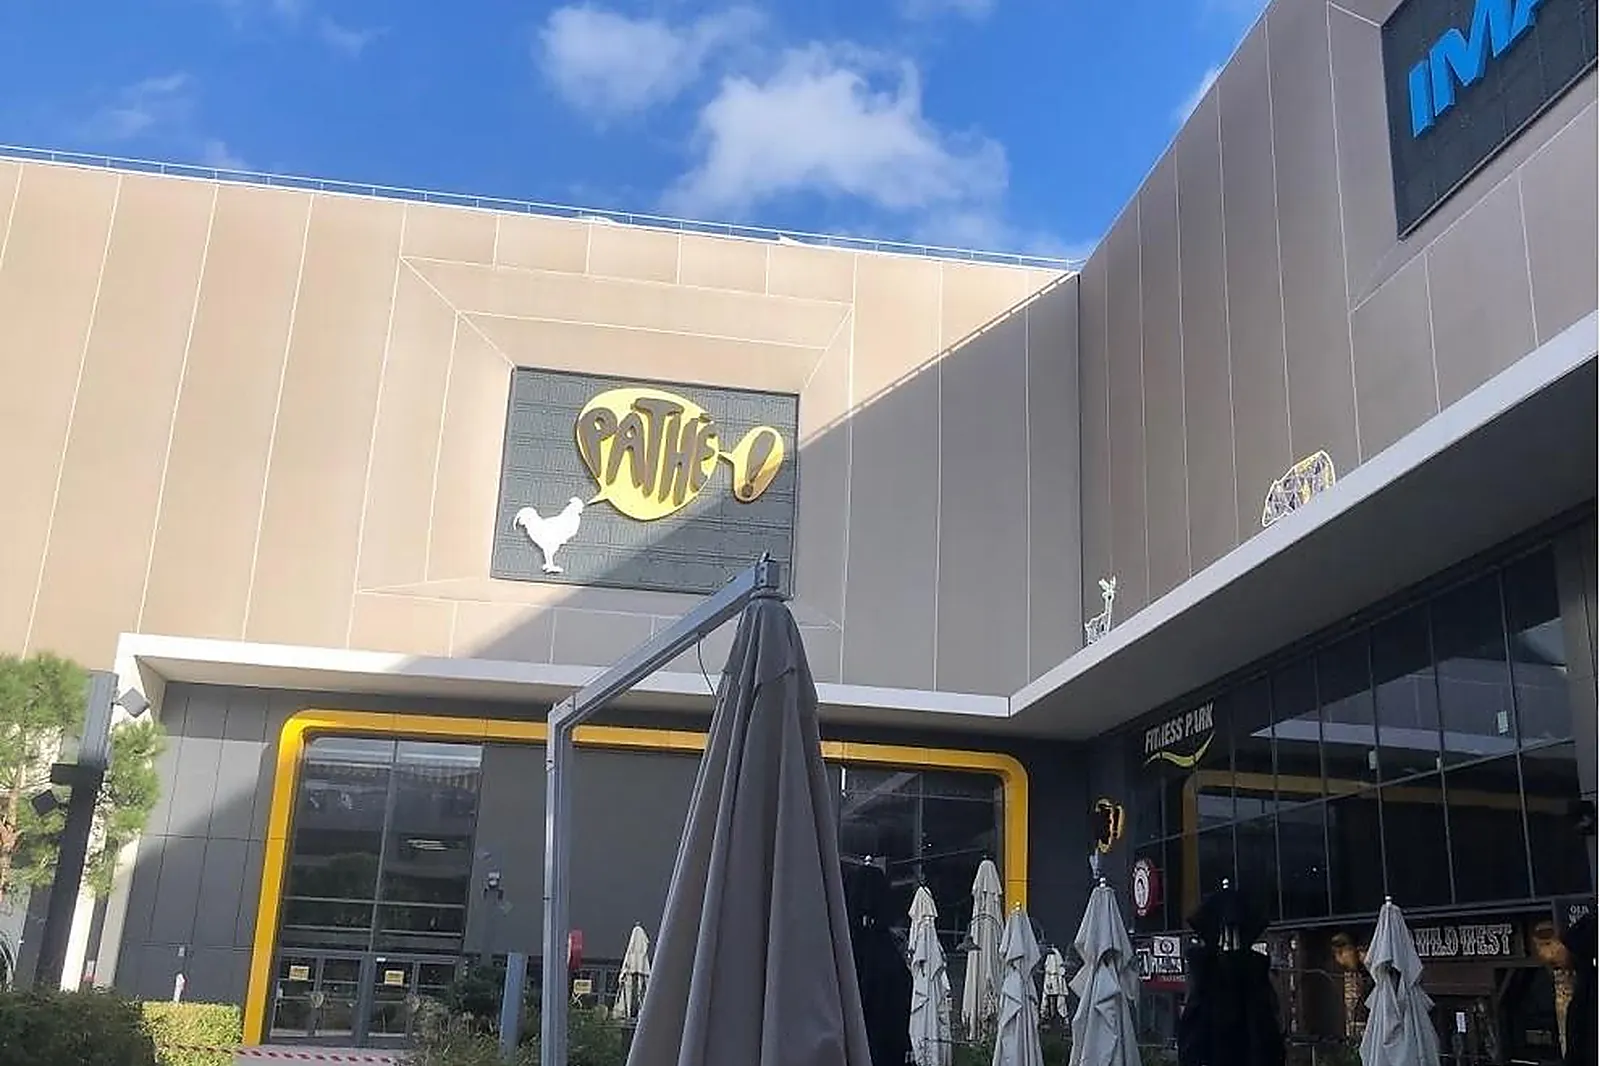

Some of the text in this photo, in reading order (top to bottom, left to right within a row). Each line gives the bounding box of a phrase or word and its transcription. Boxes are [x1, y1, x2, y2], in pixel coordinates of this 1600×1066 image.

[1145, 702, 1213, 753] FITNESS PARK
[1459, 923, 1512, 955] WEST
